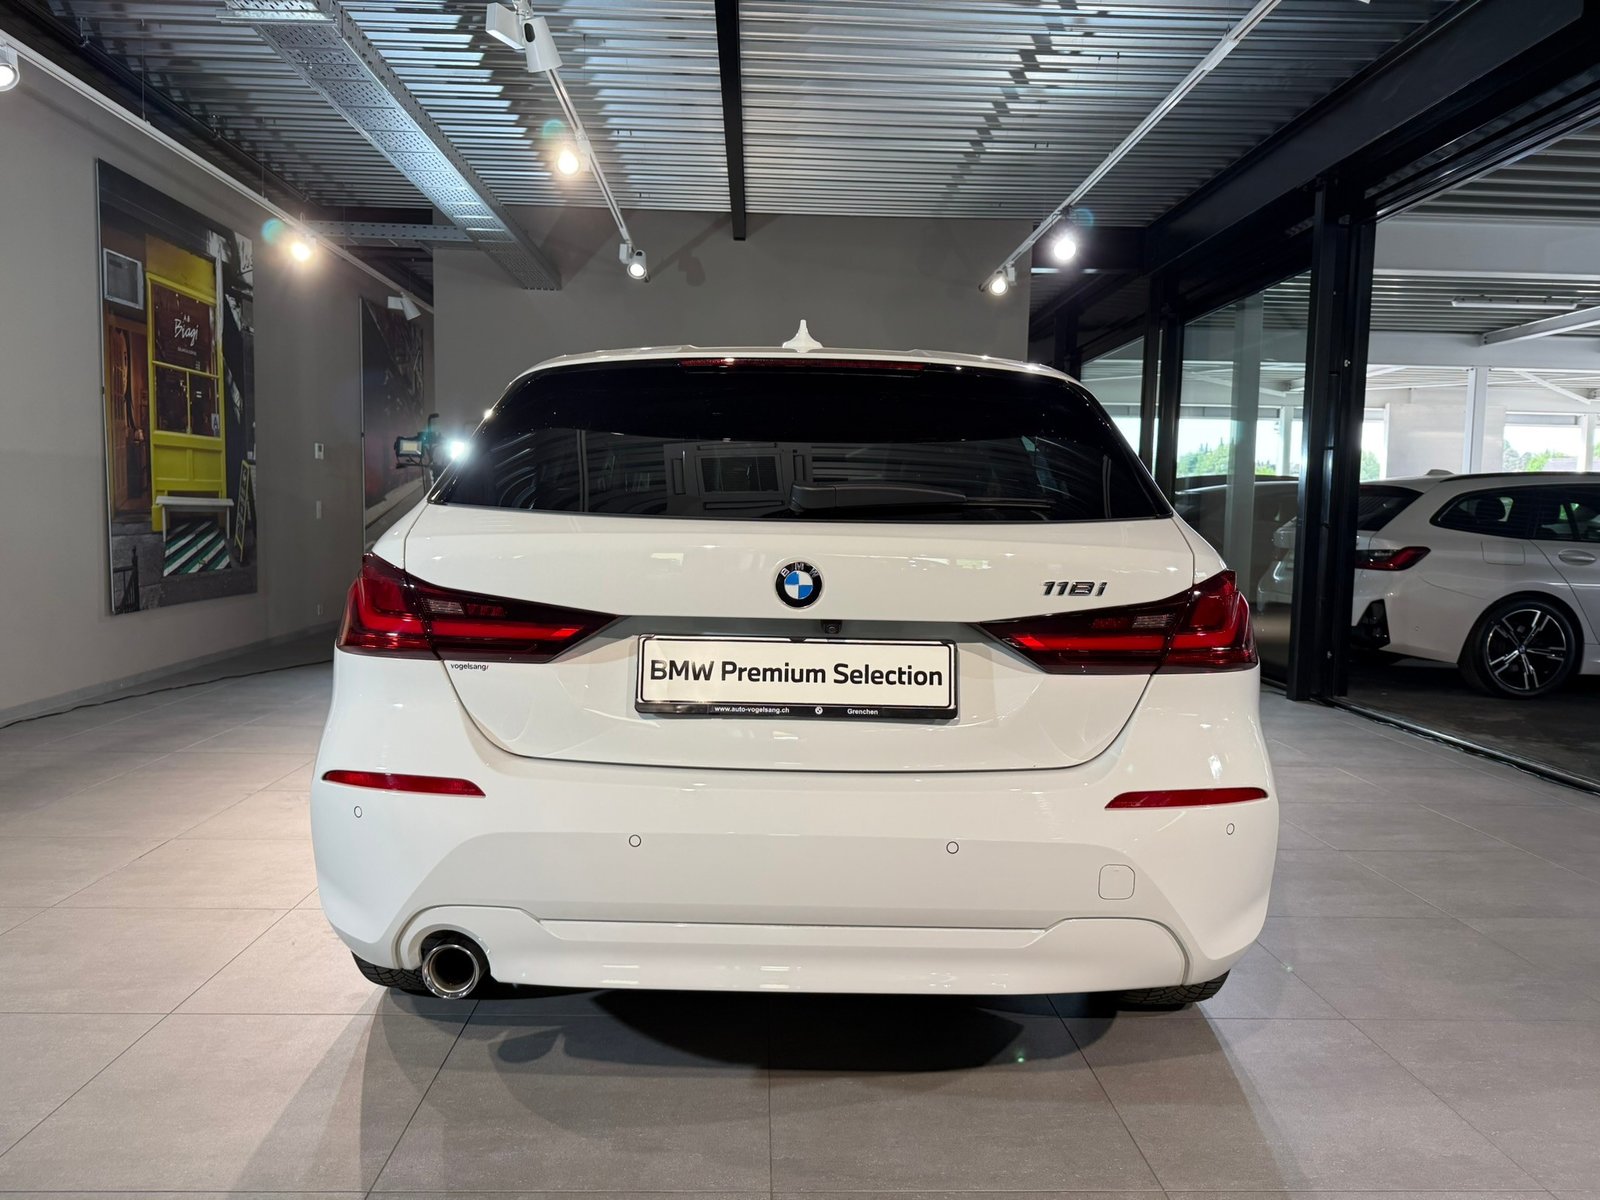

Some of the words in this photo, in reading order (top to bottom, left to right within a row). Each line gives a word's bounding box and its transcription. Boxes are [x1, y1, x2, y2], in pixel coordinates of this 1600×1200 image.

[174, 318, 199, 347] Biagi
[780, 562, 820, 578] BMW
[1043, 581, 1108, 596] 118i
[650, 659, 715, 681] BMW
[721, 661, 826, 684] Premium
[833, 663, 943, 687] Selection
[714, 705, 790, 714] www.auto-vogelsang.ch
